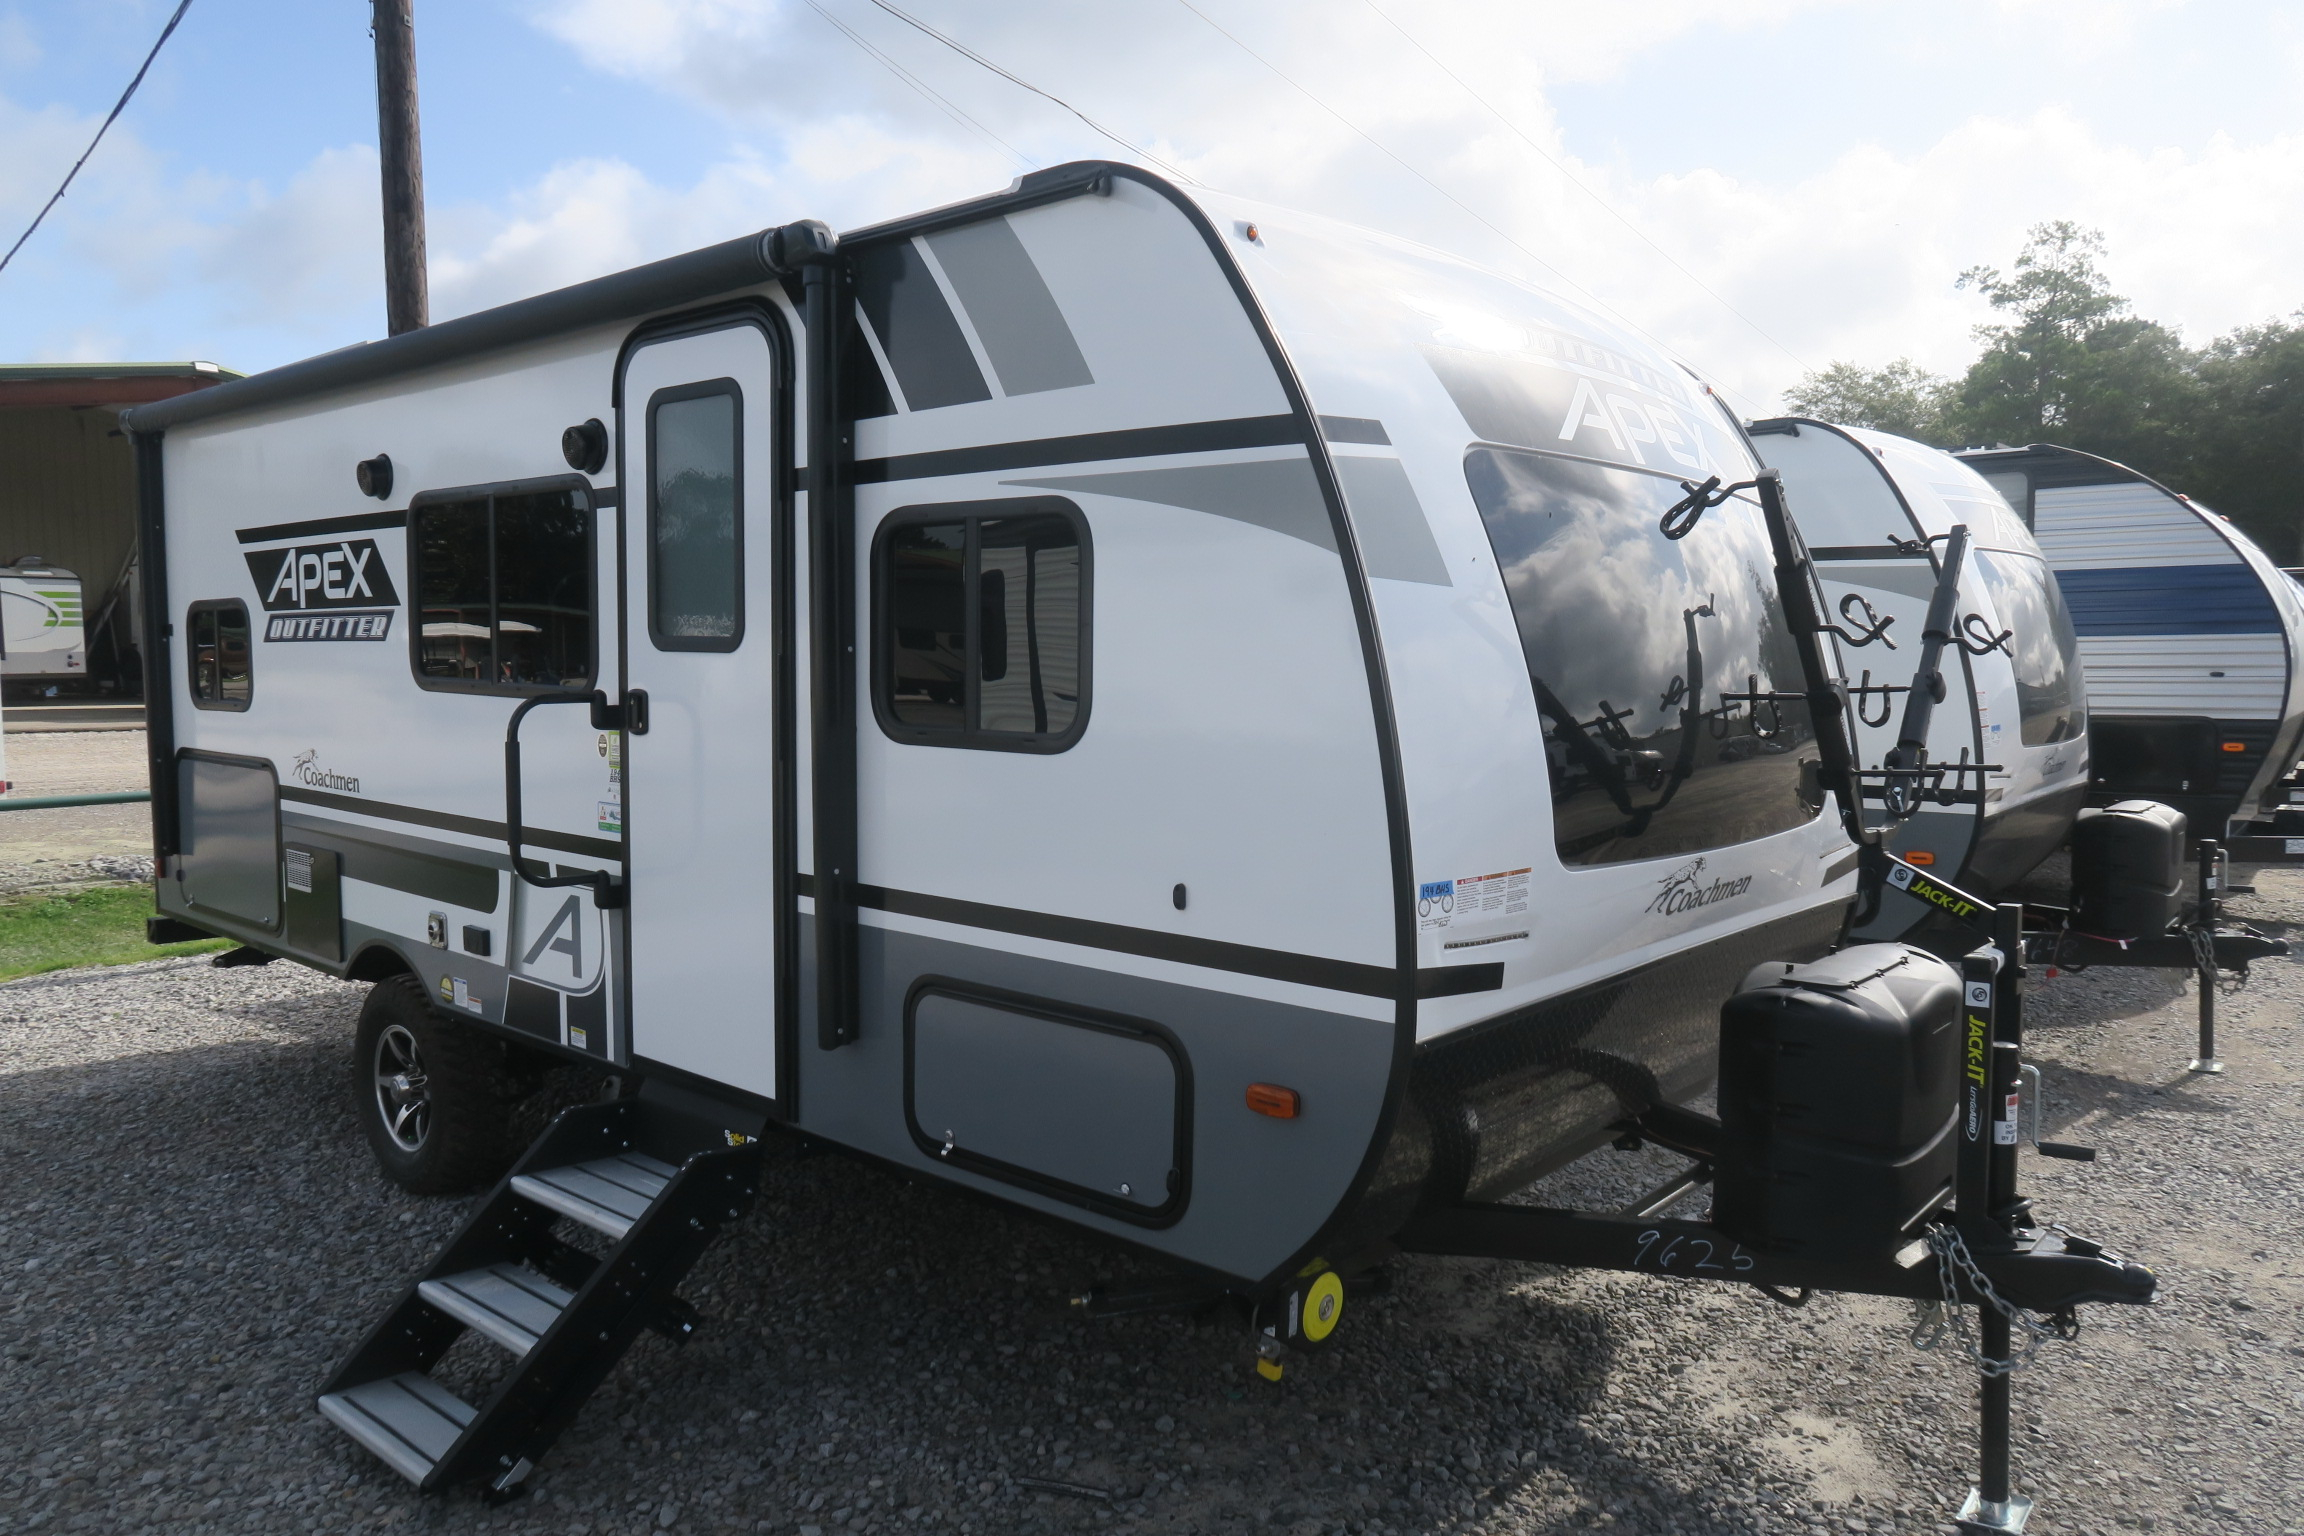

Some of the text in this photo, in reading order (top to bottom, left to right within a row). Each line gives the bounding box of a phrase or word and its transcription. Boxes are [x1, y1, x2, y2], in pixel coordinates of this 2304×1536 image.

[1558, 377, 1728, 479] APEX
[267, 543, 373, 608] APEX
[269, 615, 387, 640] OUTFITTER
[304, 767, 360, 793] Coachmen
[1422, 885, 1434, 898] 194
[1666, 875, 1752, 916] Coachmen
[1910, 880, 1976, 917] JACK-IT
[522, 894, 582, 979] A
[1967, 1014, 1987, 1087] JACK-IT
[1634, 1230, 1754, 1270] 9625
